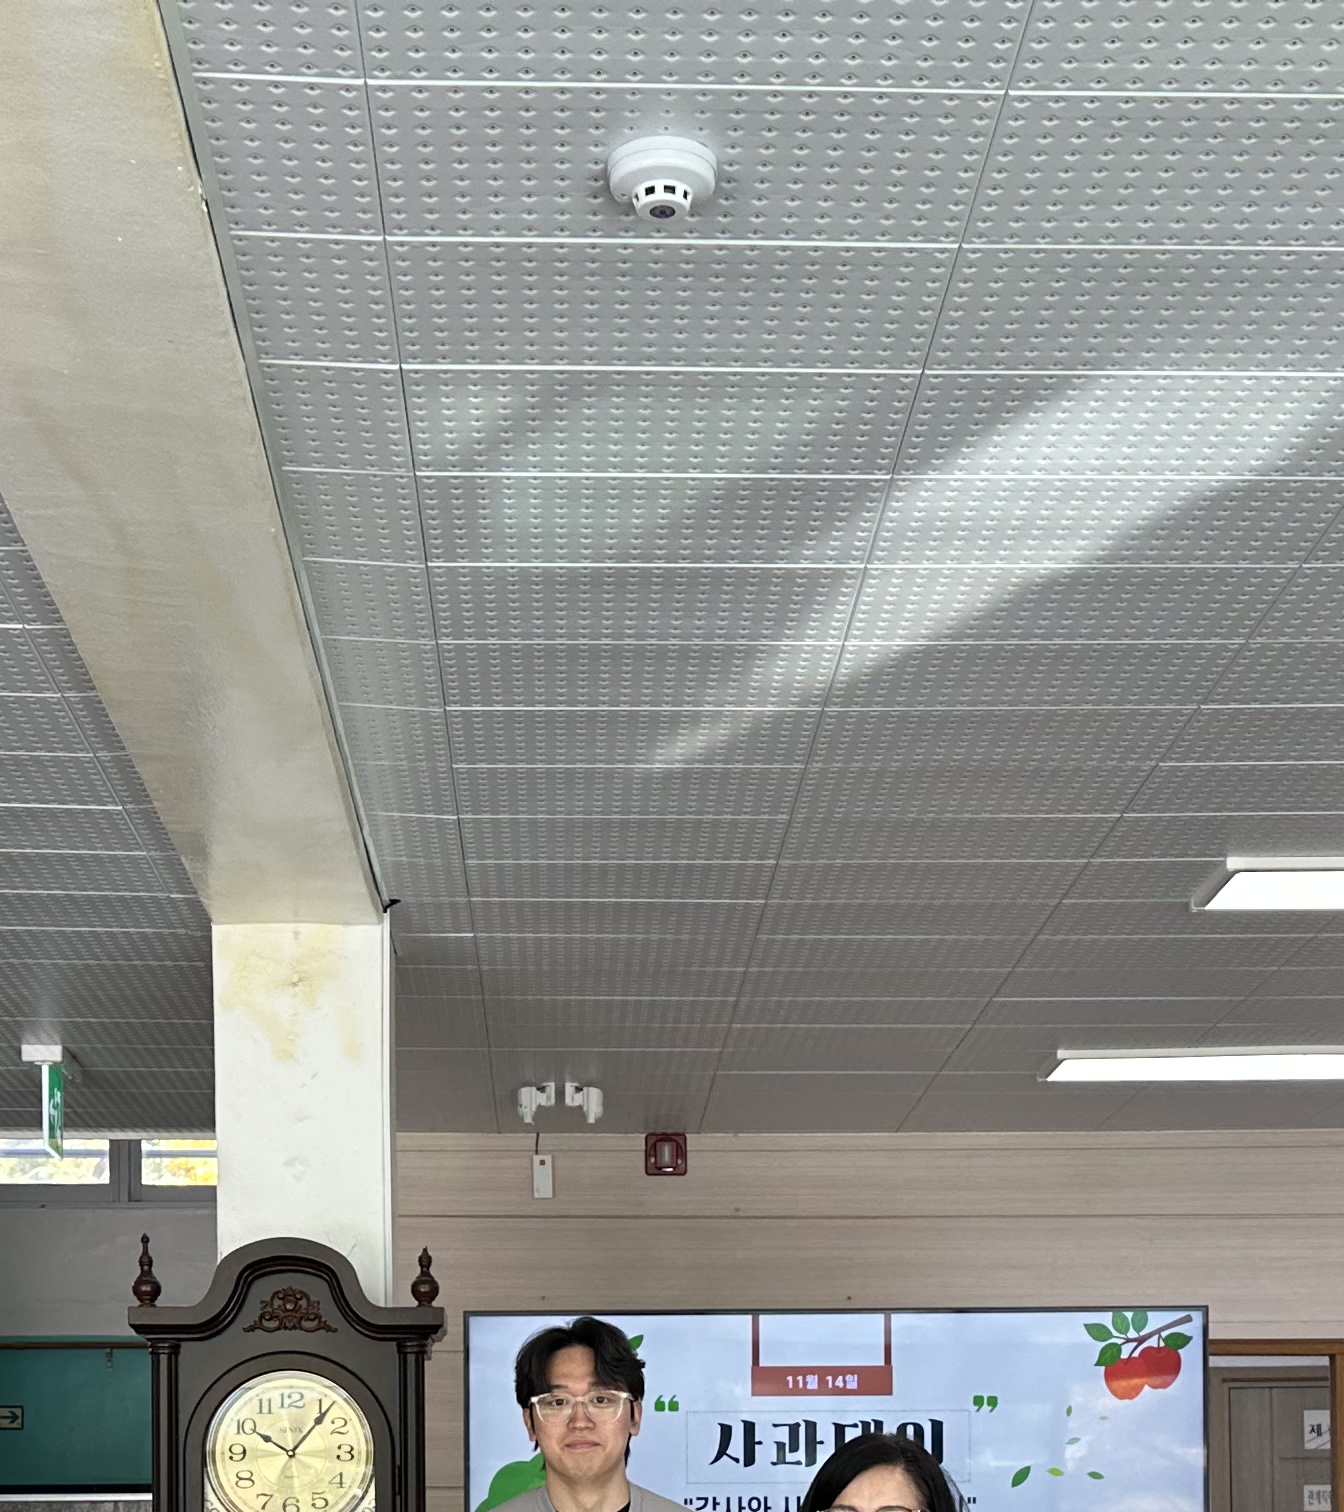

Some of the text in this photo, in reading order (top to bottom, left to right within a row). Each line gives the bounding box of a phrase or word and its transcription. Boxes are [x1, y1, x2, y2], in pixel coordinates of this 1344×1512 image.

[786, 1374, 858, 1389] 11월 14일
[257, 1398, 273, 1414] 11
[279, 1391, 305, 1409] 12
[236, 1418, 256, 1435] 10
[330, 1417, 348, 1435] 2
[228, 1443, 246, 1462] 9
[336, 1444, 354, 1461] 3
[235, 1470, 255, 1488] 8
[328, 1472, 344, 1488] 4
[257, 1493, 273, 1510] 7
[311, 1491, 329, 1509] 5
